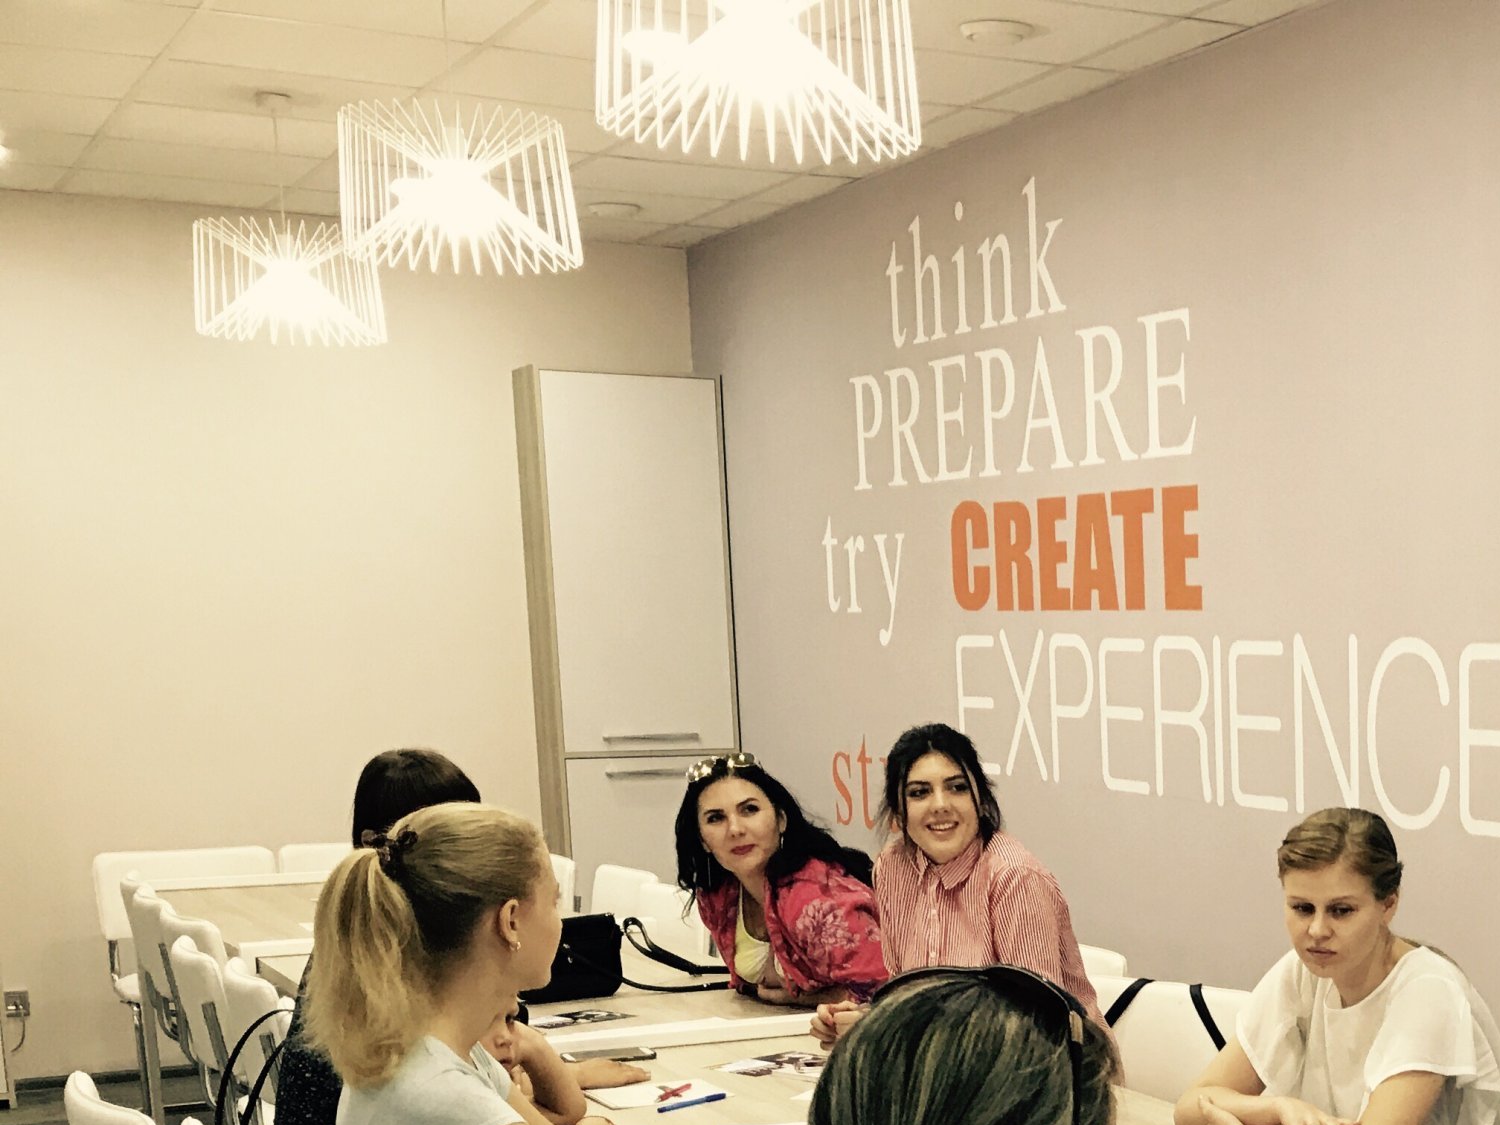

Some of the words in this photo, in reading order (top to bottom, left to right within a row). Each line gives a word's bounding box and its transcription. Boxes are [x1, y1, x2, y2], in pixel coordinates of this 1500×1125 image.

[885, 176, 1066, 349] think
[849, 307, 1198, 491] PREPARE
[821, 515, 905, 646] try
[950, 484, 1203, 612] CREATE
[832, 733, 900, 834] st
